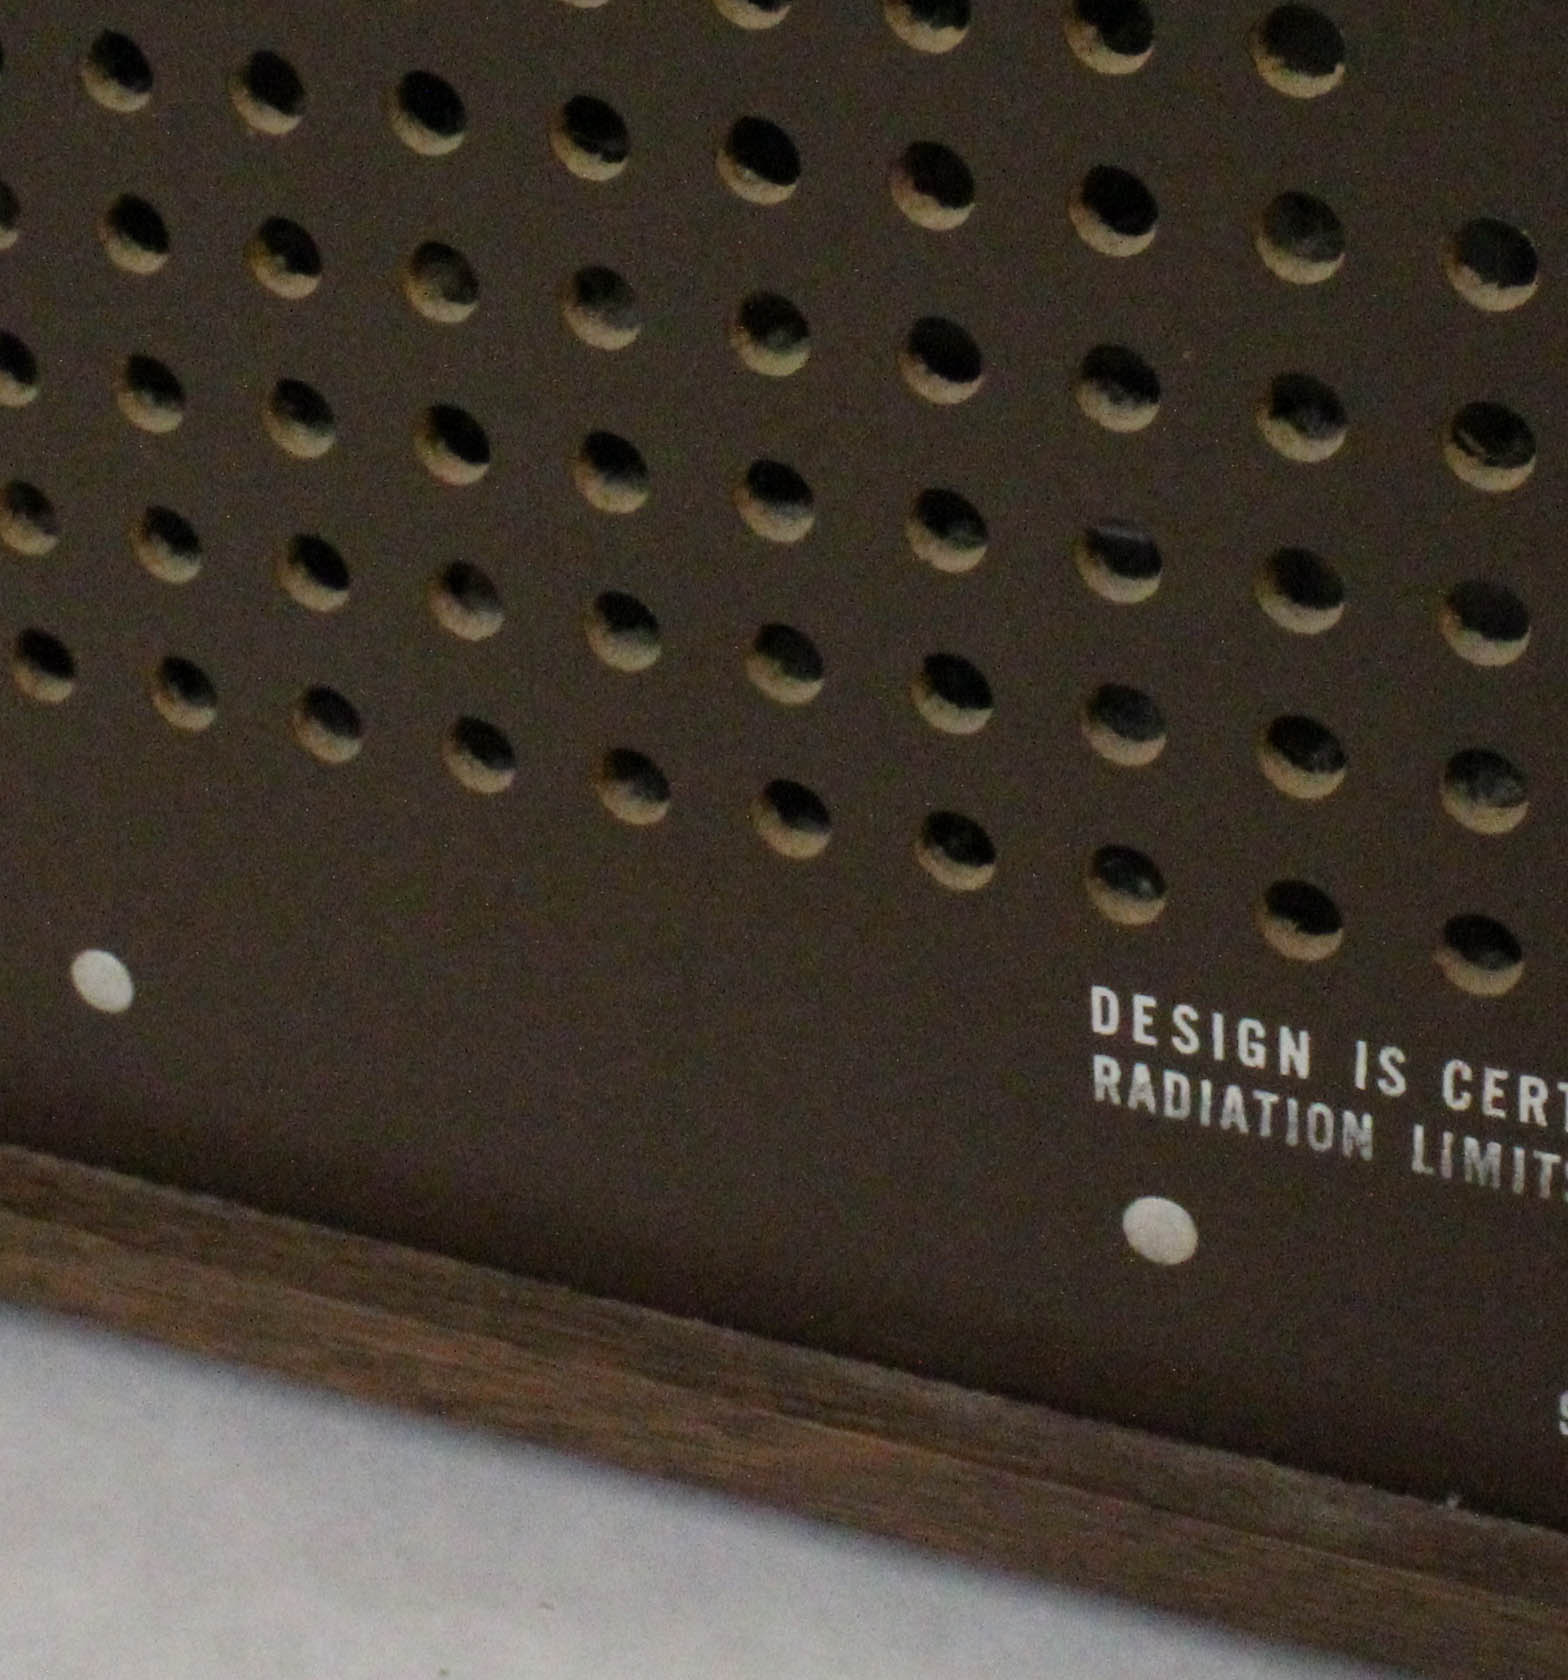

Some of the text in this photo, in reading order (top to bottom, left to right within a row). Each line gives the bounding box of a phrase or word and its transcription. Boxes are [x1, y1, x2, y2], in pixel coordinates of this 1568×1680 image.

[1091, 985, 1310, 1081] DESIGN
[1356, 1040, 1406, 1098] IS
[1092, 1054, 1374, 1161] RADIATION
